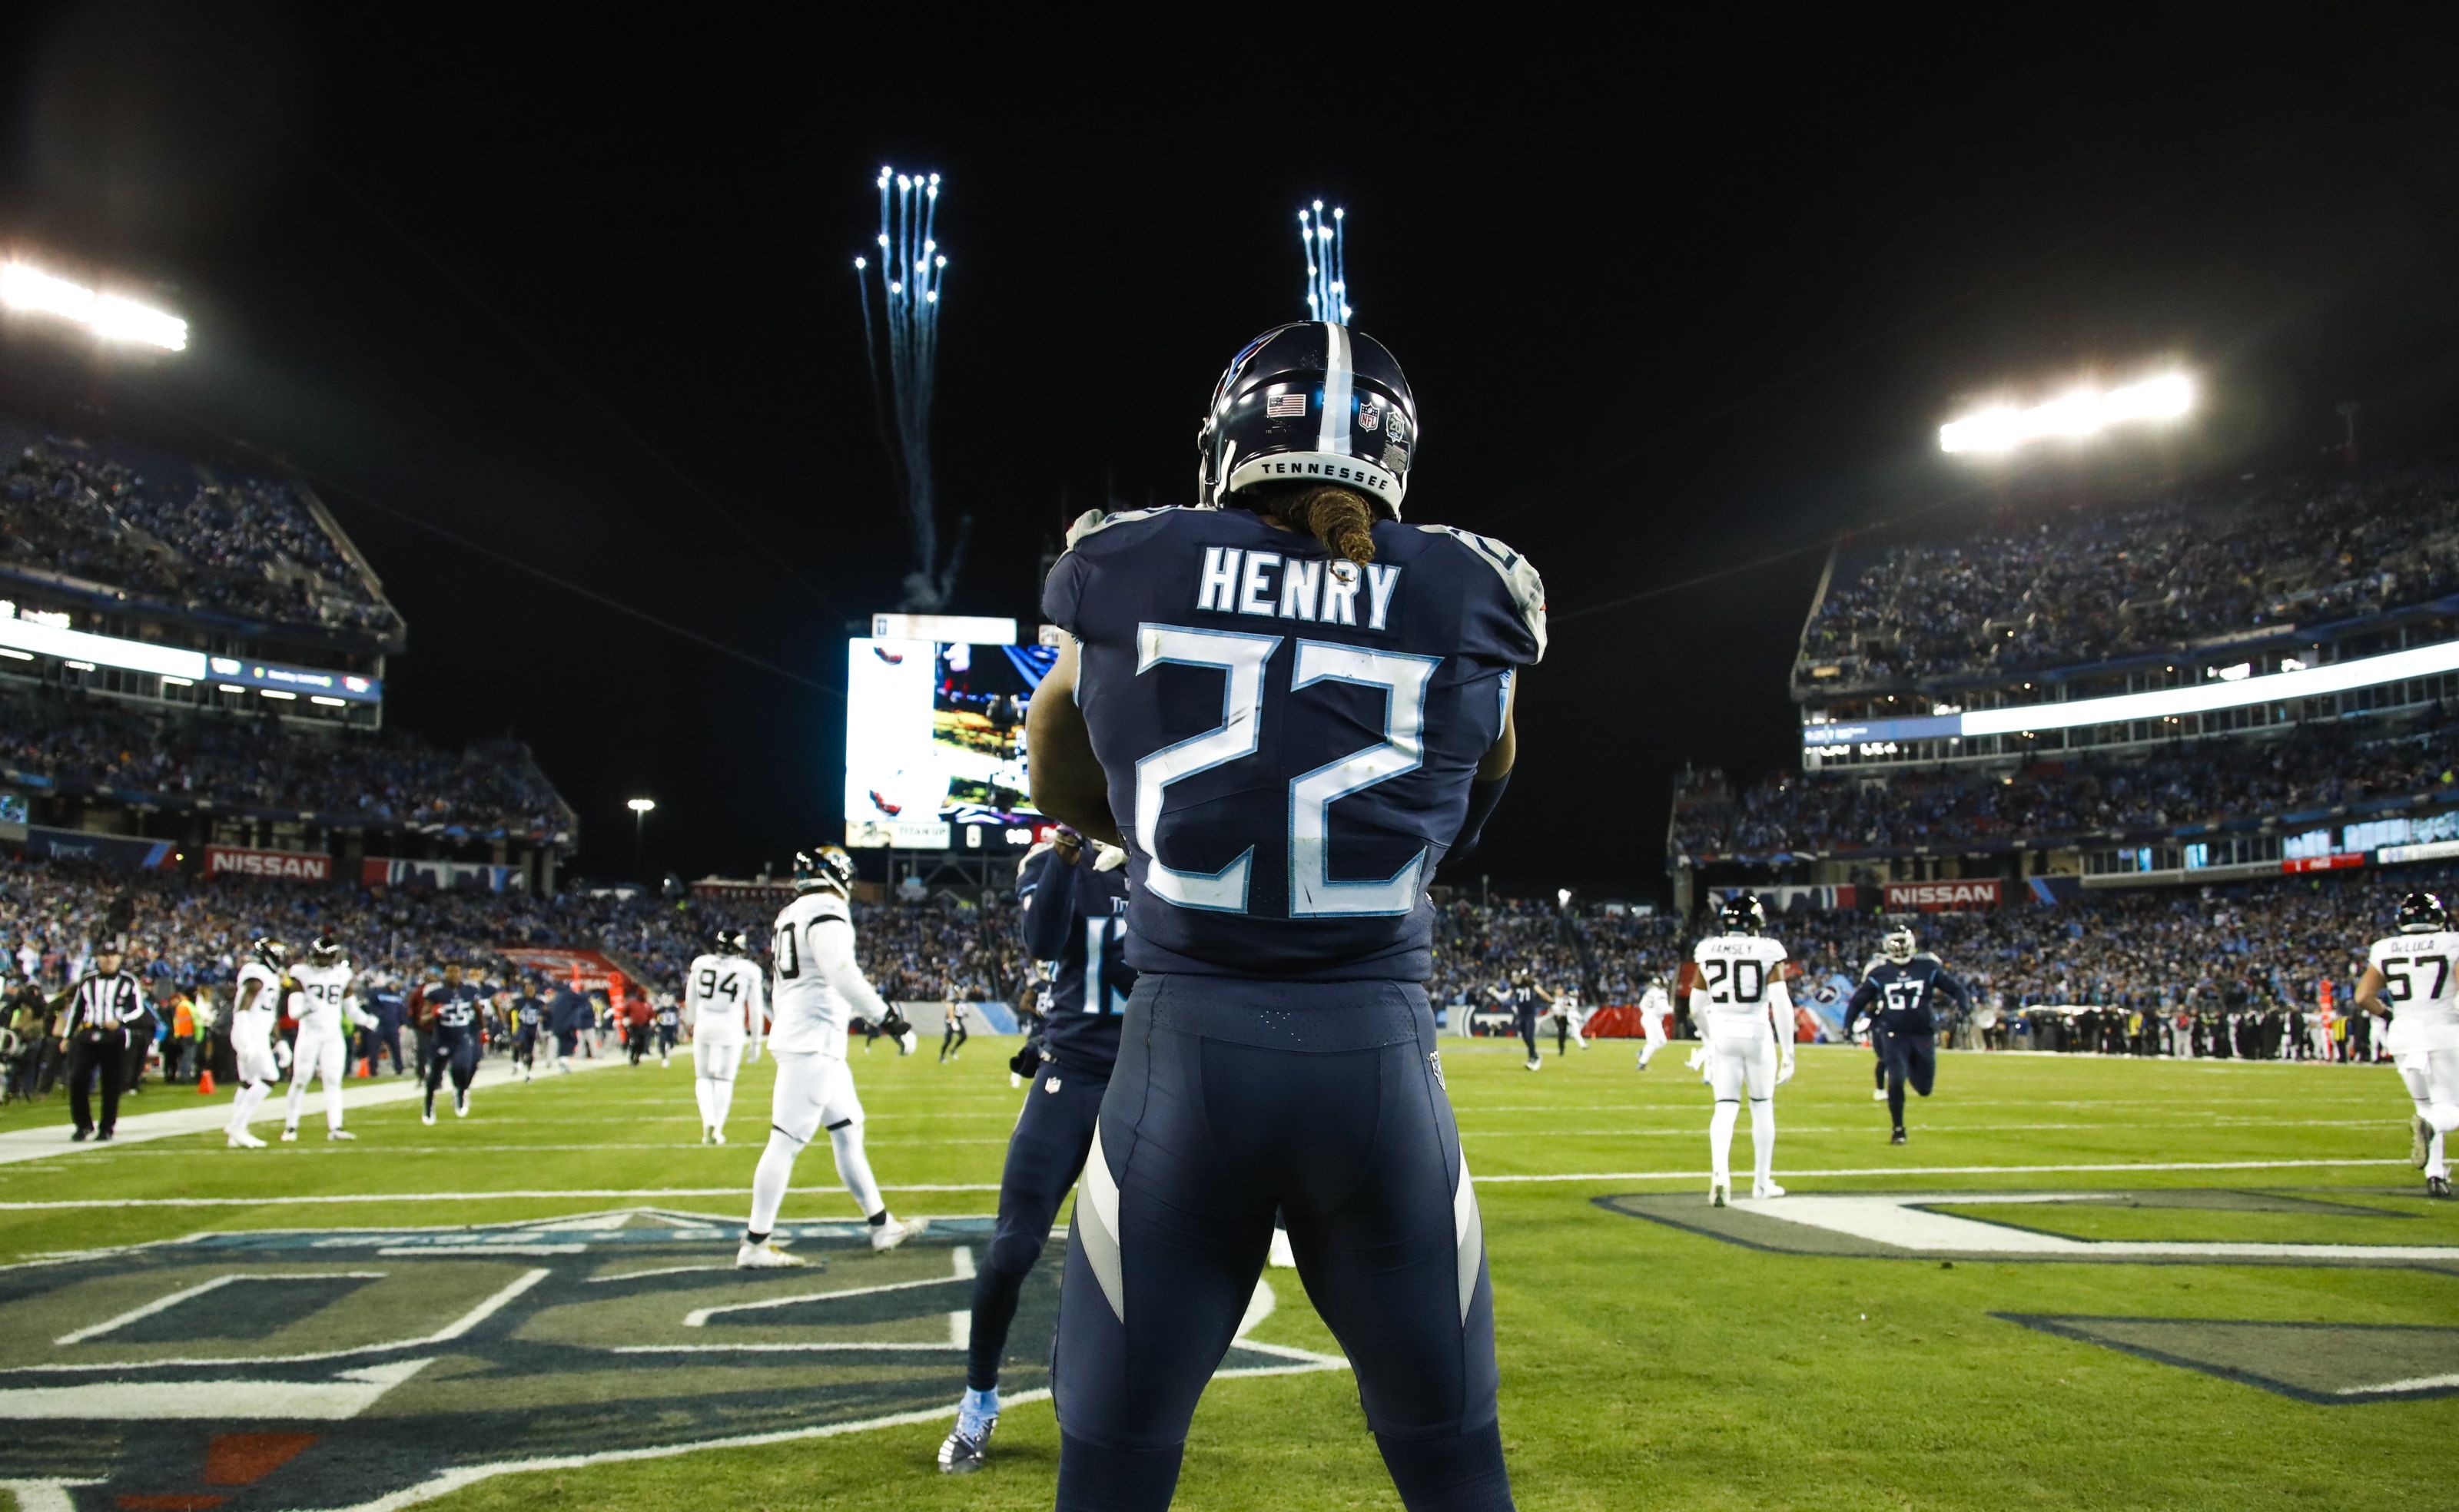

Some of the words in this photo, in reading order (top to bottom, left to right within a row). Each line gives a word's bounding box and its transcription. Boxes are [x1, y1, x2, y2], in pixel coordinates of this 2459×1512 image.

[1361, 413, 1376, 428] NFL
[1389, 417, 1402, 433] 20
[1262, 463, 1388, 490] TENNESSEE
[1196, 546, 1402, 631] HENRY
[1136, 622, 1445, 919] 22
[212, 851, 324, 879] NISSAN
[1890, 885, 1995, 904] NISSAN
[699, 969, 738, 1003] 94
[1705, 959, 1763, 1003] 20
[2381, 954, 2449, 1001] 57
[1884, 980, 1924, 1010] 67
[440, 1002, 471, 1027] 55
